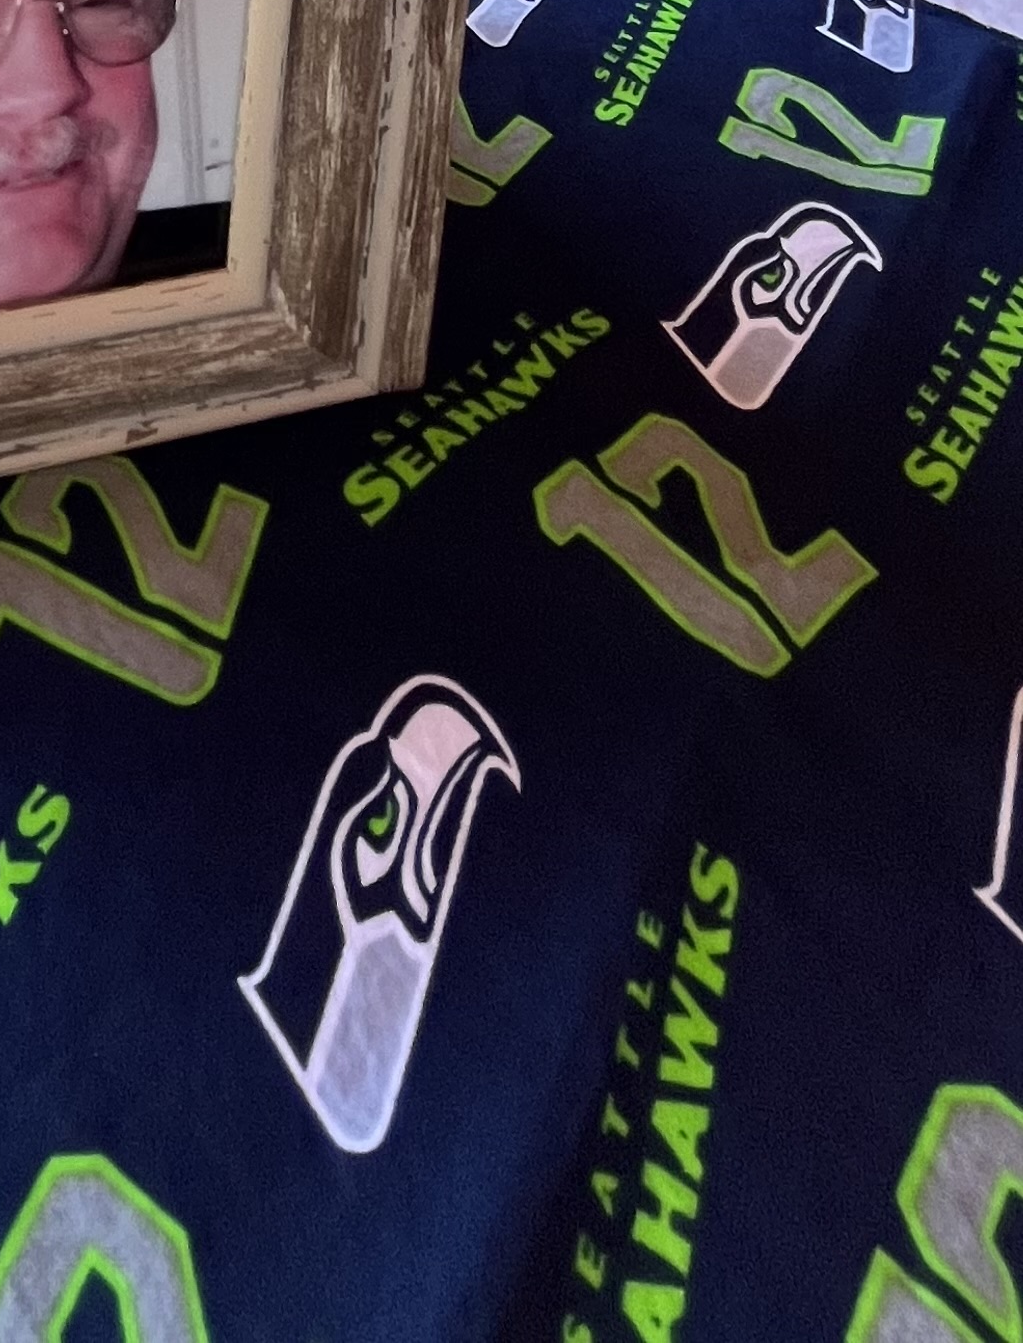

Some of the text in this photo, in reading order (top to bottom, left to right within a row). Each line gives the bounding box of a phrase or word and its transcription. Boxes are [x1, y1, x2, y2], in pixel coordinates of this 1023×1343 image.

[718, 67, 947, 197] 12
[342, 306, 612, 527] SEAHAWKS
[901, 275, 1023, 505] SEAHAW
[903, 267, 1003, 427] SEATTLE
[532, 412, 880, 679] 12
